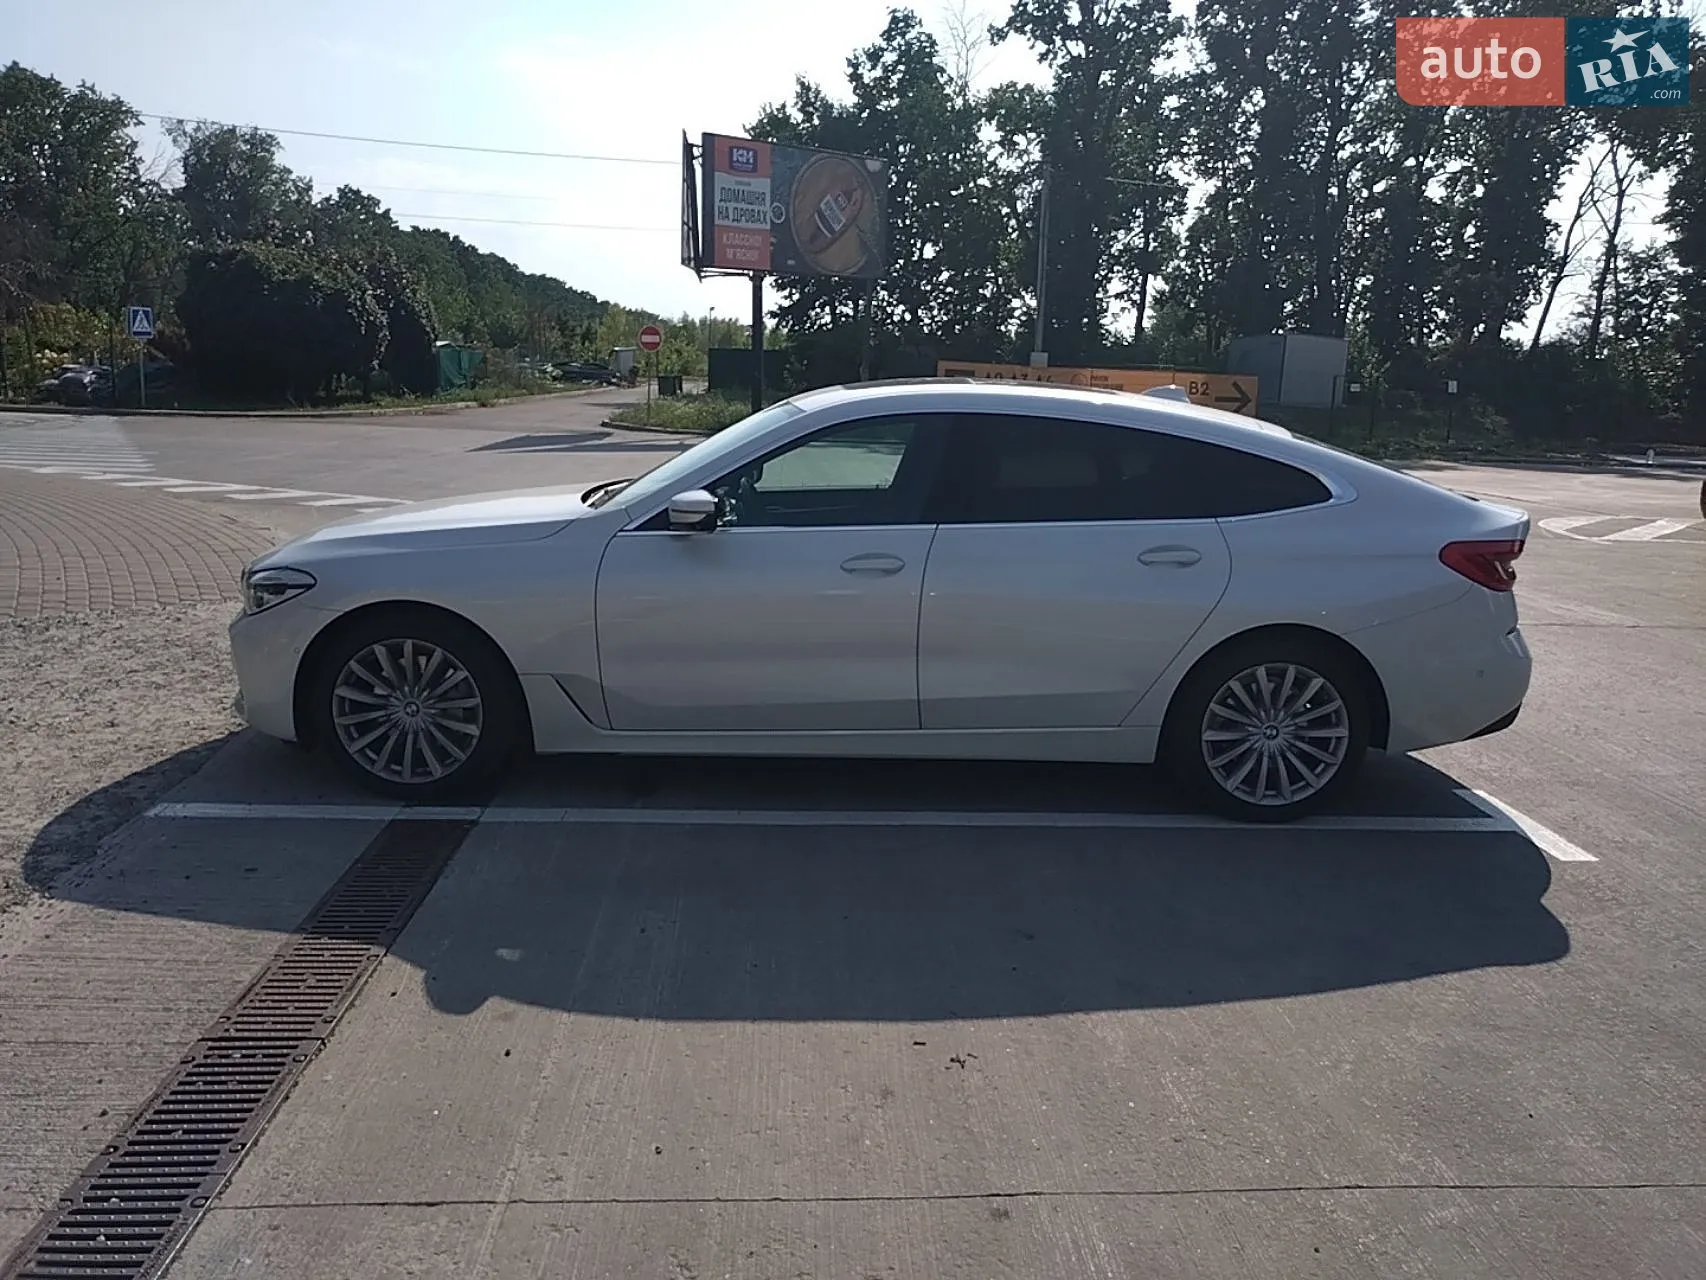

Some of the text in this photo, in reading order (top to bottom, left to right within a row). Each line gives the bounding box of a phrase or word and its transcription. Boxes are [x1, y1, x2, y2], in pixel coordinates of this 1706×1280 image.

[719, 186, 766, 207] ДОМАШНЯ
[717, 204, 767, 225] НА ДРОВАХ
[1189, 381, 1209, 396] B2
